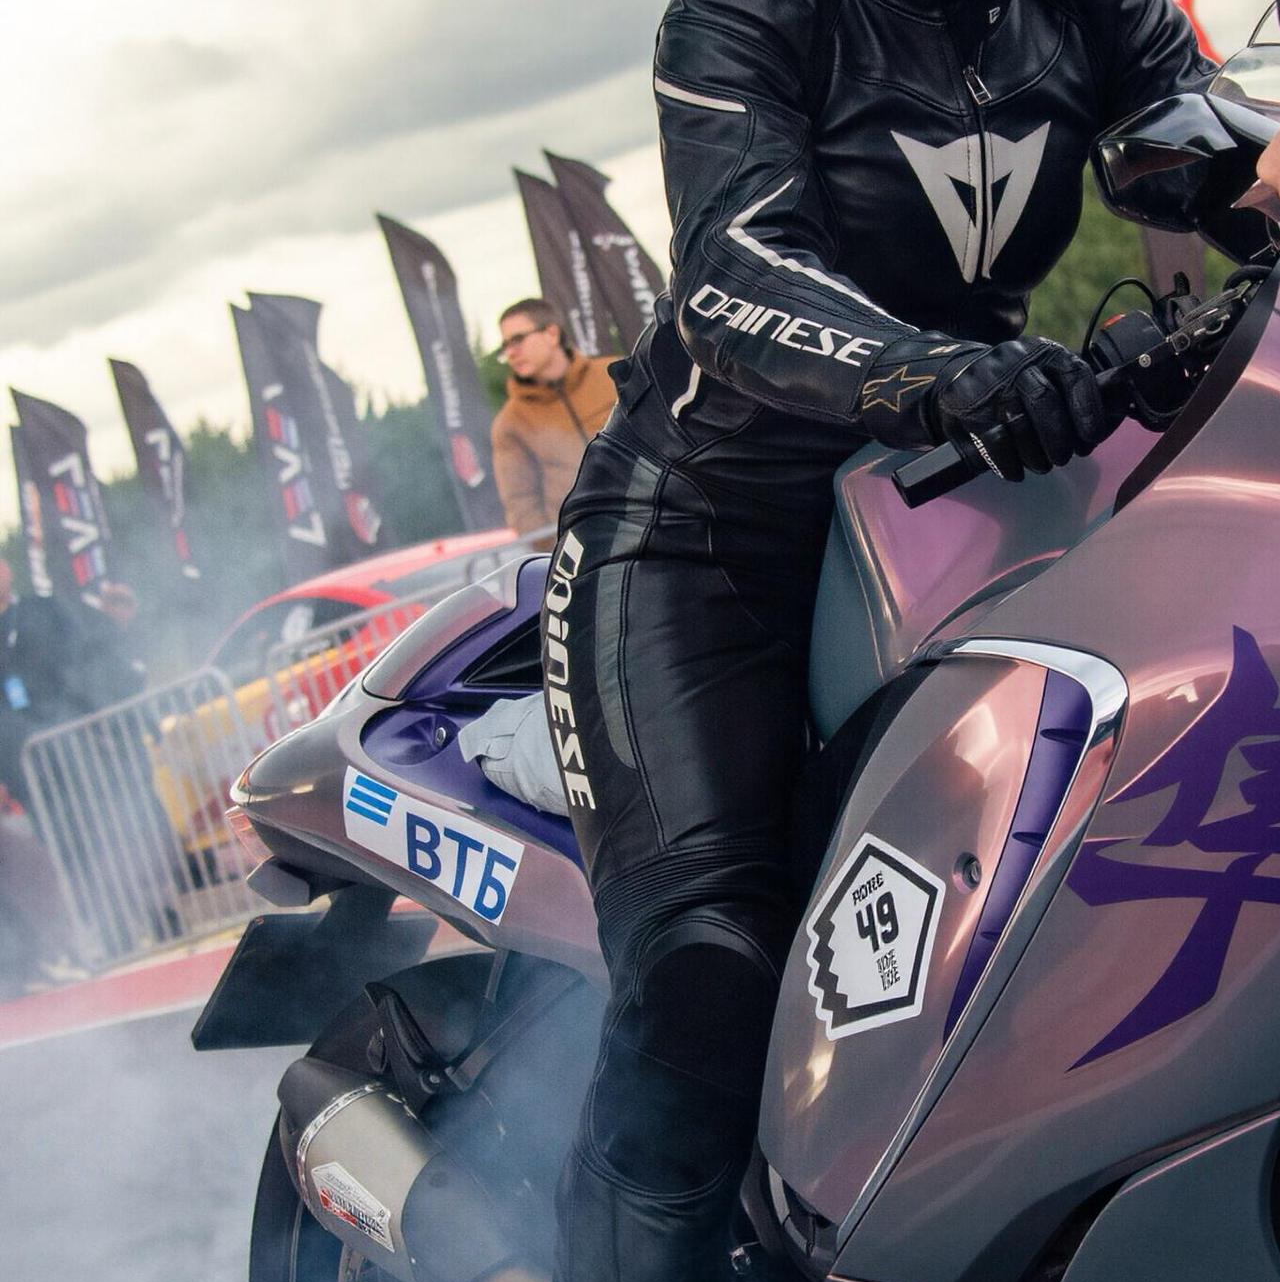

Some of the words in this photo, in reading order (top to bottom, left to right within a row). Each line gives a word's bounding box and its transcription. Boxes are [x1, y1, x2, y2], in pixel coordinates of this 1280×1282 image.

[688, 284, 885, 367] DAINESE
[546, 529, 596, 810] DAINESE
[405, 811, 517, 921] ВТБ
[856, 891, 900, 954] 49
